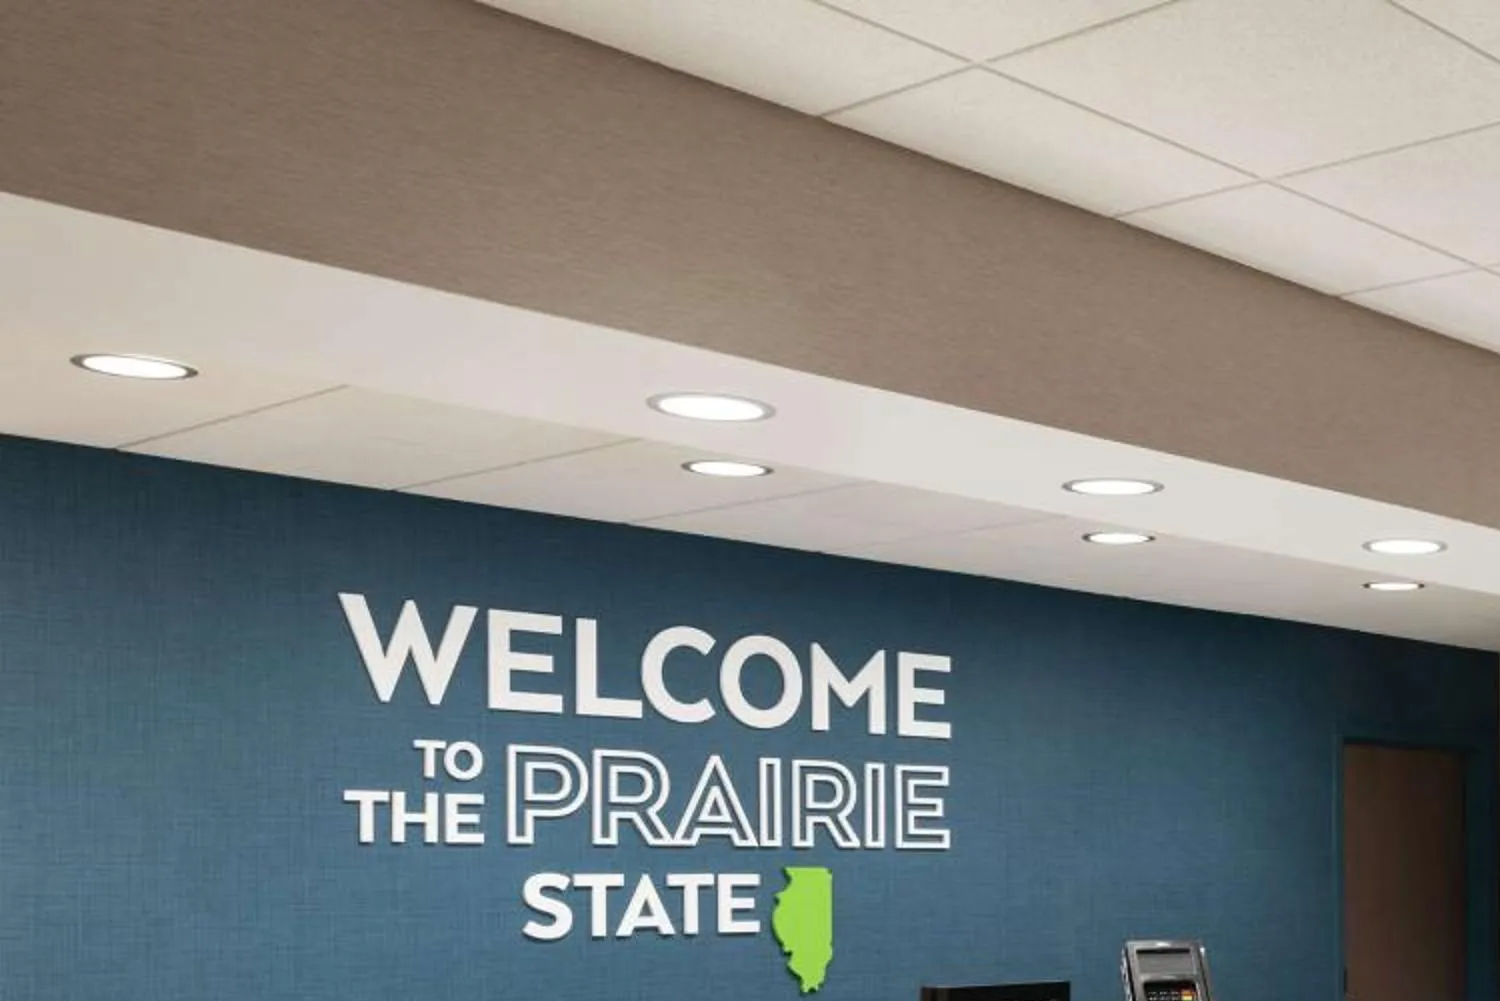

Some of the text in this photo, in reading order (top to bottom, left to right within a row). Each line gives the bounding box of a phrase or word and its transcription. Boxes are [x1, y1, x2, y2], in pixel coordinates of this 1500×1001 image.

[338, 592, 953, 739] WELCOME
[343, 743, 951, 850] THE PRAIRIE
[413, 739, 484, 781] TO
[522, 872, 762, 941] STATE
